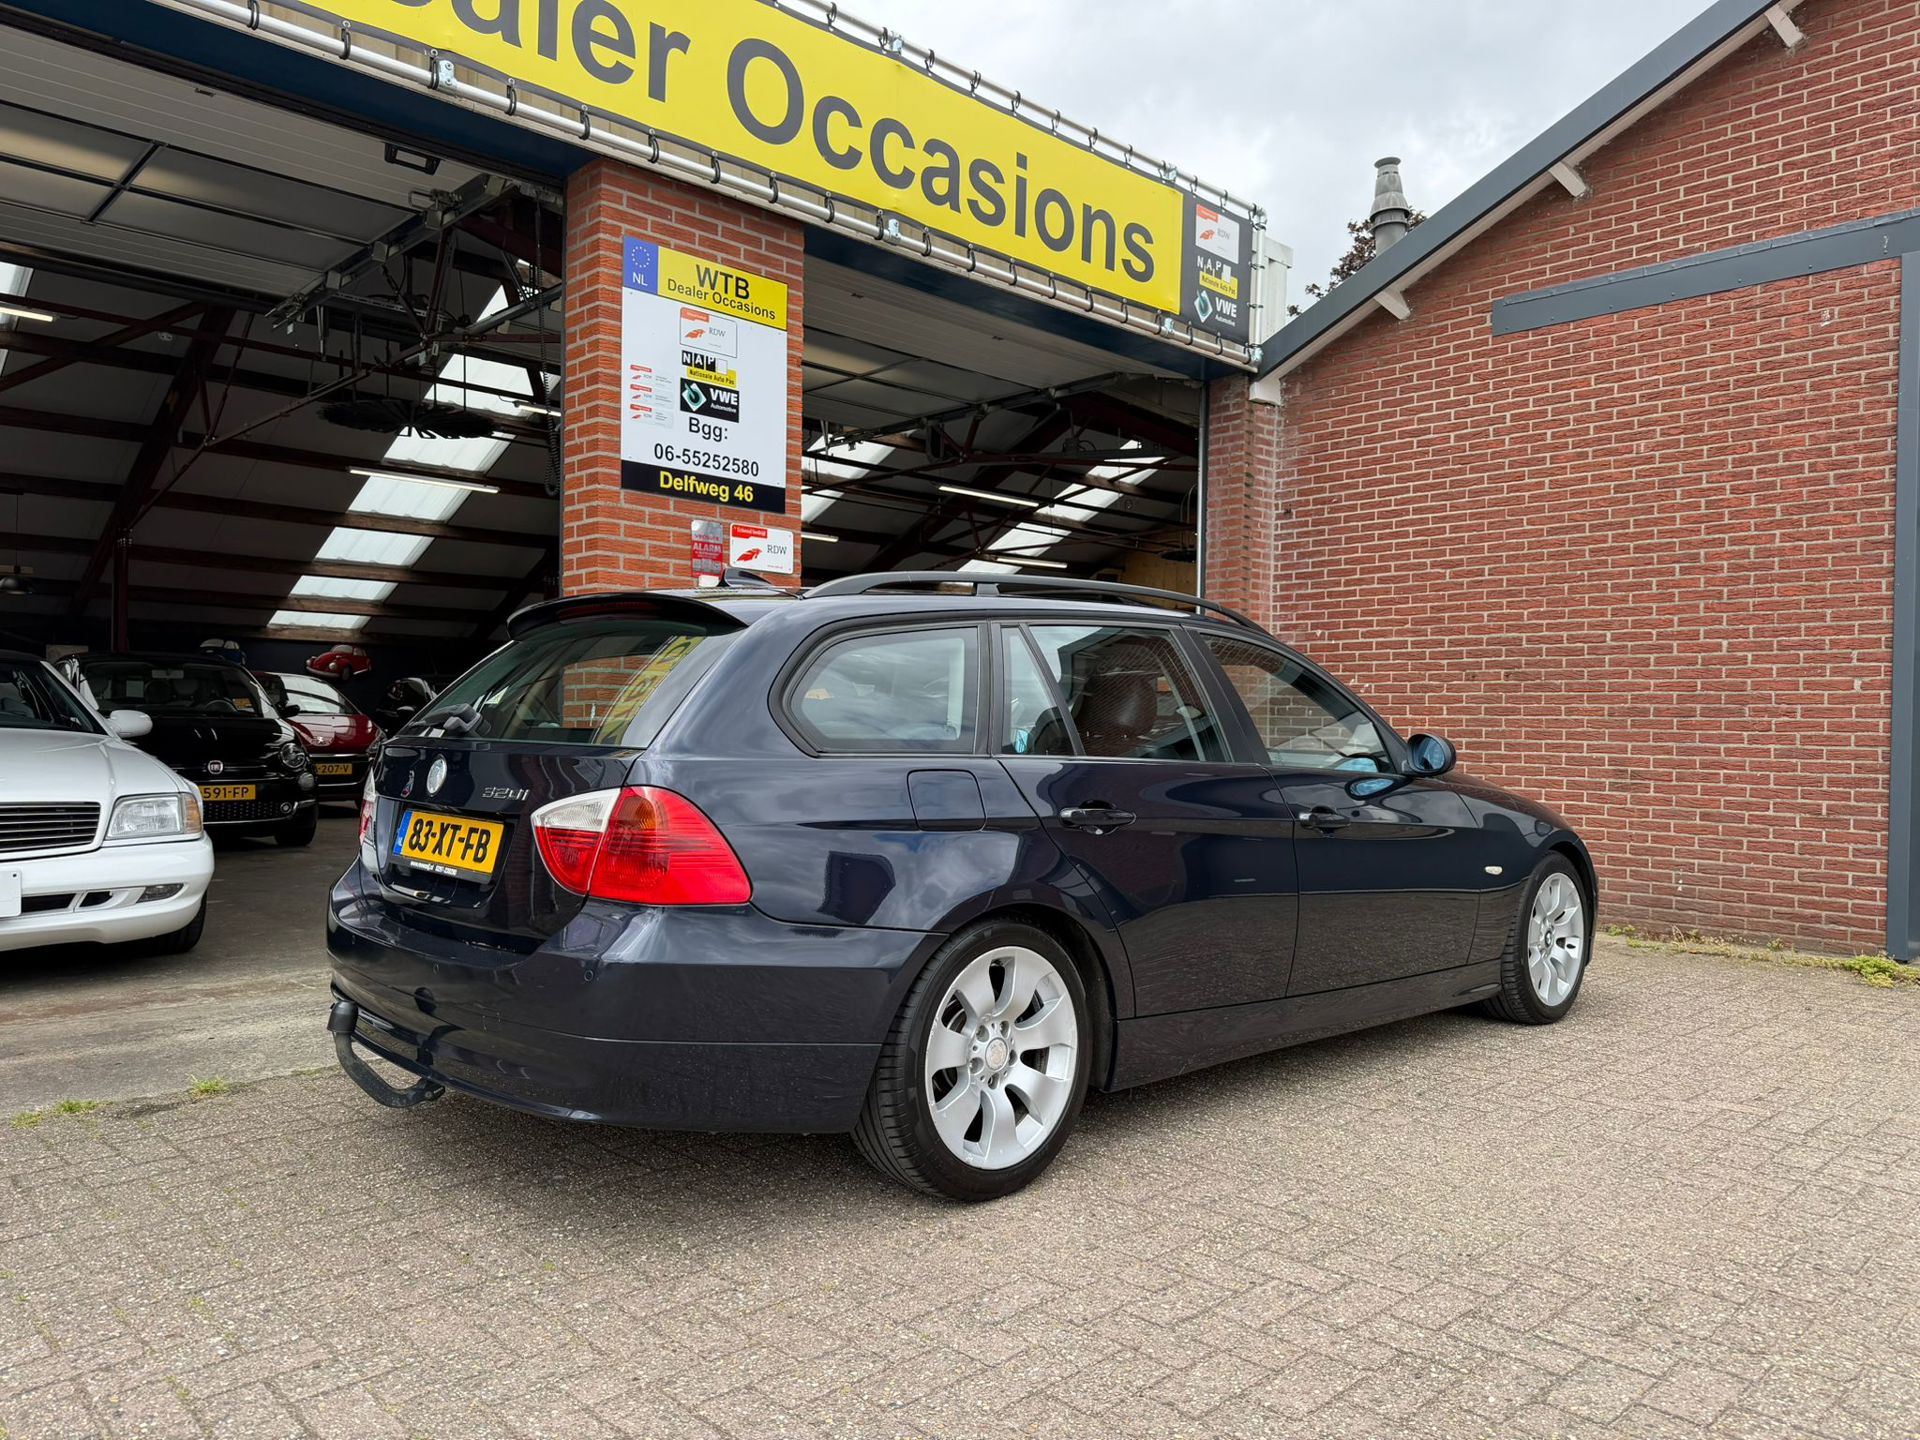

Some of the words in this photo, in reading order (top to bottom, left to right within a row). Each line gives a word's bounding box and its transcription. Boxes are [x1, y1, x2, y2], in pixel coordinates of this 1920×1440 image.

[391, 0, 692, 103] aler
[727, 38, 1155, 283] Occasions
[632, 272, 648, 287] NL
[696, 264, 750, 300] WTB
[667, 278, 709, 301] Dealer
[712, 291, 776, 320] Occasions
[1215, 296, 1238, 318] VWE
[709, 387, 739, 406] VWE
[710, 402, 737, 414] Automotive
[689, 416, 728, 442] Bgg:
[654, 443, 759, 477] 06-55252580
[659, 470, 730, 502] Delfweg
[734, 484, 754, 502] 46
[693, 542, 721, 554] ALARM
[767, 544, 788, 555] RDW
[408, 818, 491, 864] 83-XT-FB
